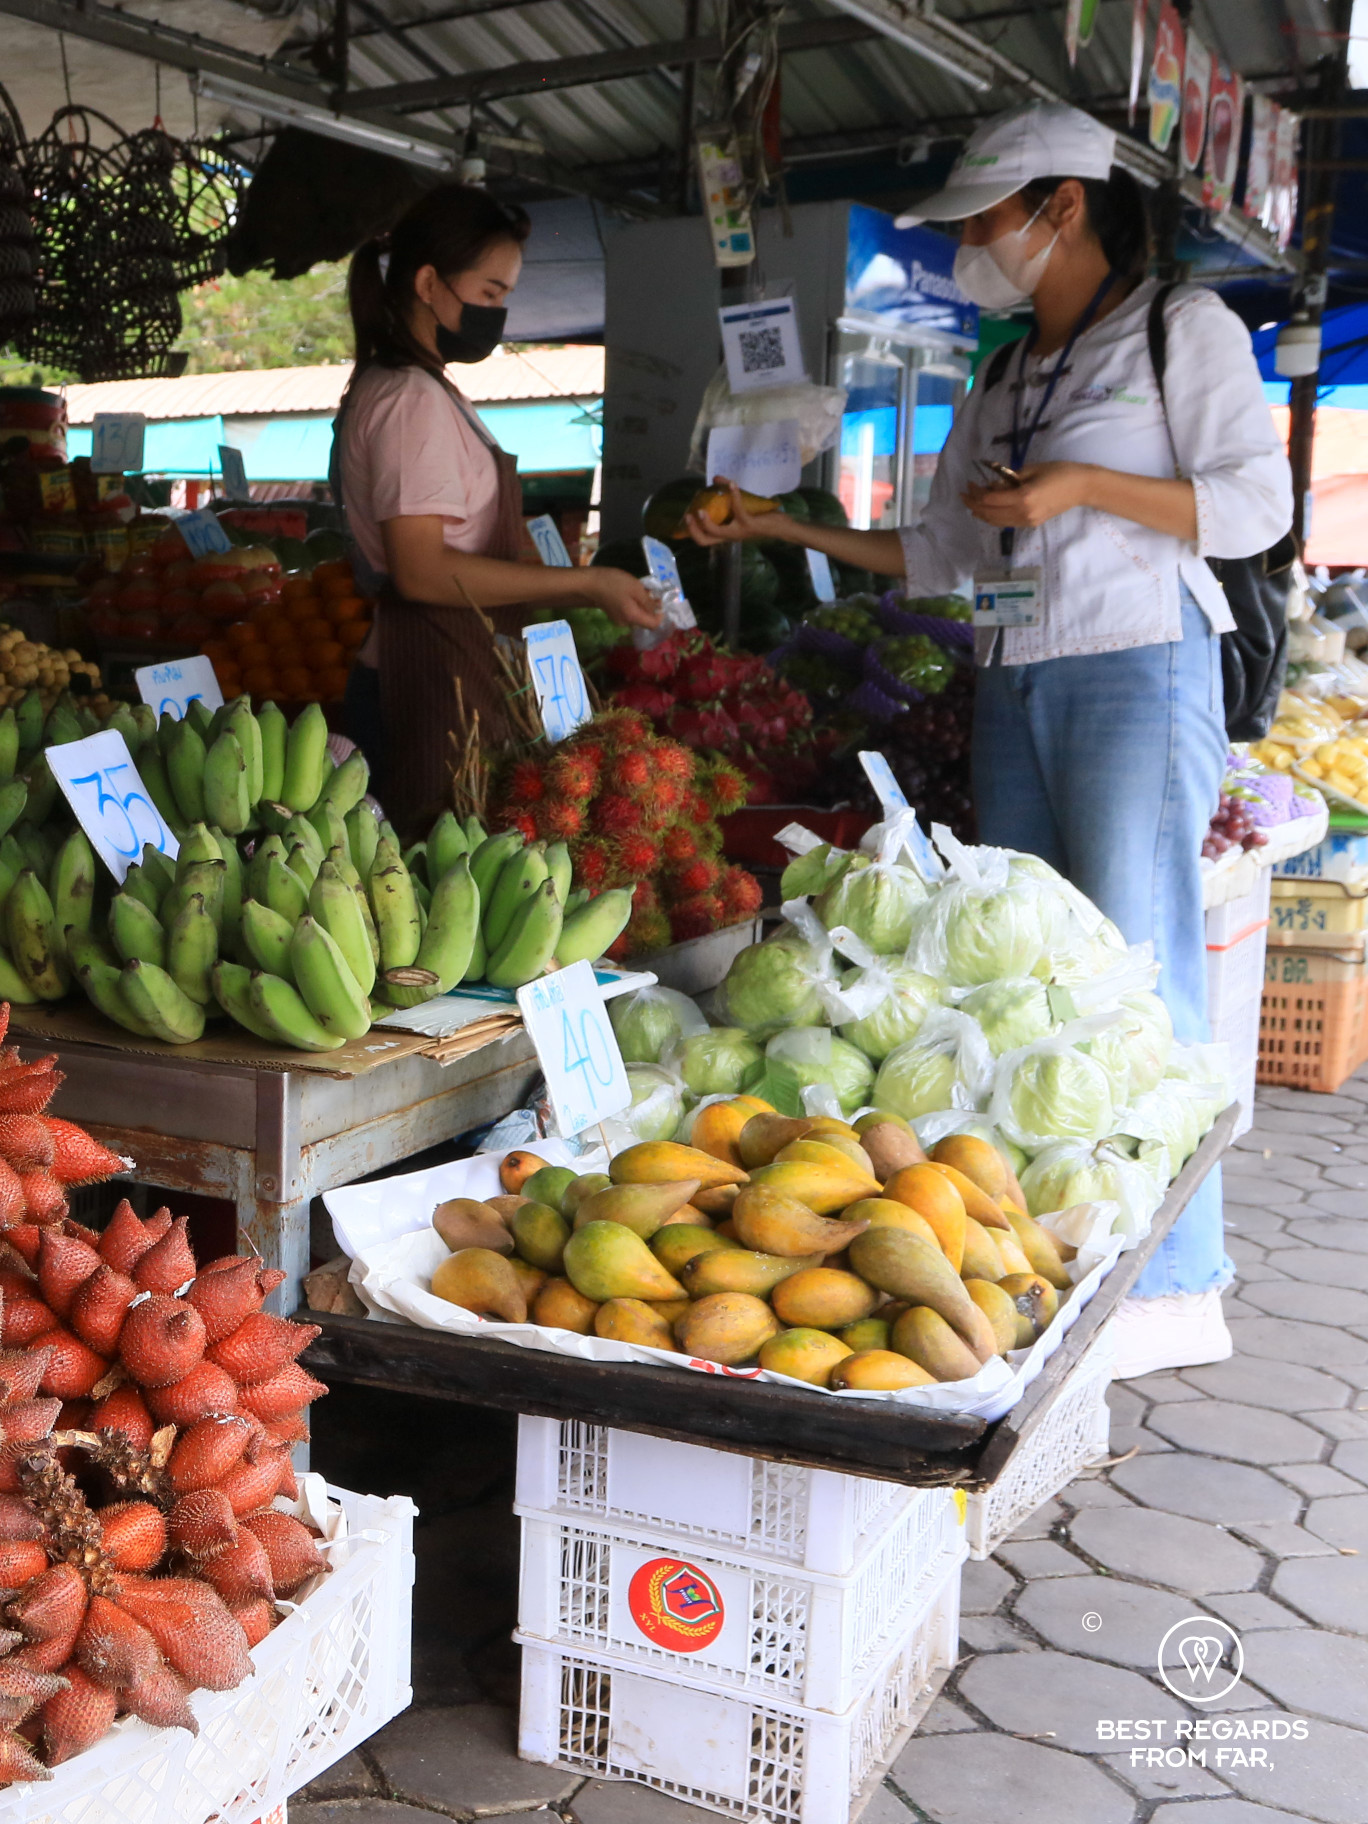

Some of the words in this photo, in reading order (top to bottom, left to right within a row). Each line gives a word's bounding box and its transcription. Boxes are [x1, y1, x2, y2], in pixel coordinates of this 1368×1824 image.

[534, 654, 585, 731] 70
[69, 763, 166, 859] 35
[562, 1008, 614, 1110] 40
